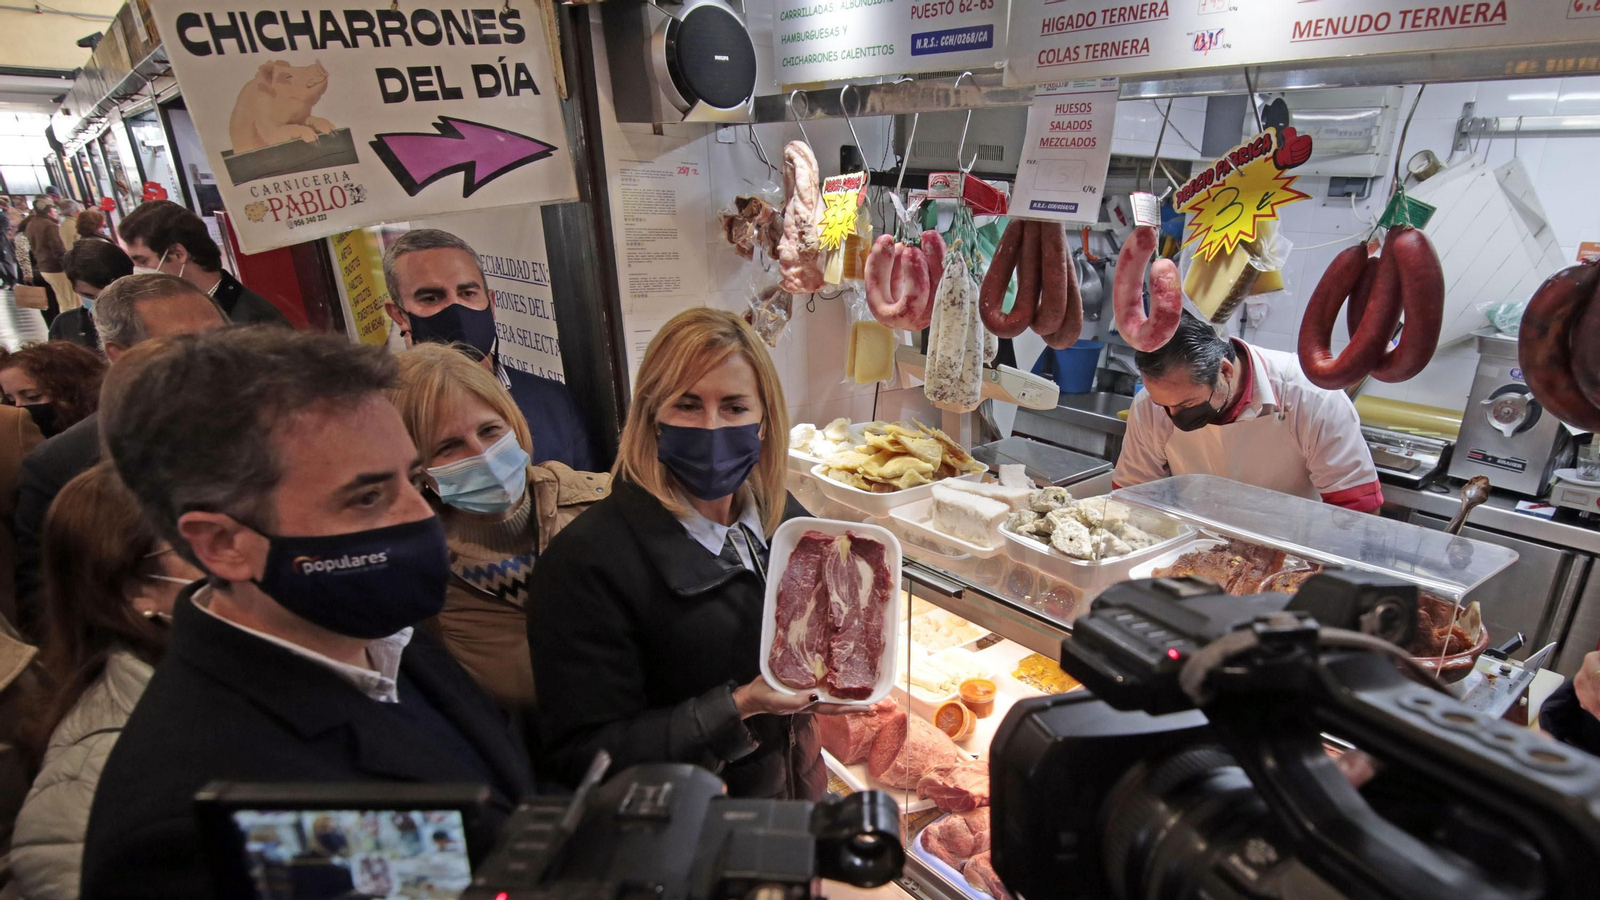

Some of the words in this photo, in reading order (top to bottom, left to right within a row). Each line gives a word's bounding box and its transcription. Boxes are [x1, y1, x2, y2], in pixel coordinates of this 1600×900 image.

[911, 1, 955, 20] PUESTO
[1041, 11, 1096, 34] HIGADO
[1101, 0, 1169, 25] TERNERA
[1292, 12, 1391, 39] MENUDO
[1399, 2, 1508, 29] TERNERA
[175, 8, 526, 57] CHICHARRONES
[781, 26, 840, 44] HAMBURGUESAS
[842, 25, 848, 35] Y
[782, 50, 838, 68] CHICHARRONES
[841, 44, 895, 60] CALENTITOS
[1037, 45, 1080, 65] COLAS
[1084, 37, 1150, 60] TERNERA
[375, 65, 463, 104] DEL
[471, 56, 541, 97] DÍA
[1055, 102, 1092, 114] HUESOS
[1049, 120, 1093, 131] SALADOS
[1039, 137, 1097, 148] MEZCLADOS
[250, 171, 350, 198] CARNICERIA
[1175, 168, 1215, 210] PRECIO
[267, 185, 347, 222] PABLO
[1211, 186, 1244, 233] 3
[480, 254, 531, 280] ECIALIDAD
[494, 290, 527, 314] RONES
[528, 297, 549, 320] DEL
[495, 322, 517, 344] ERA
[302, 552, 388, 576] populares
